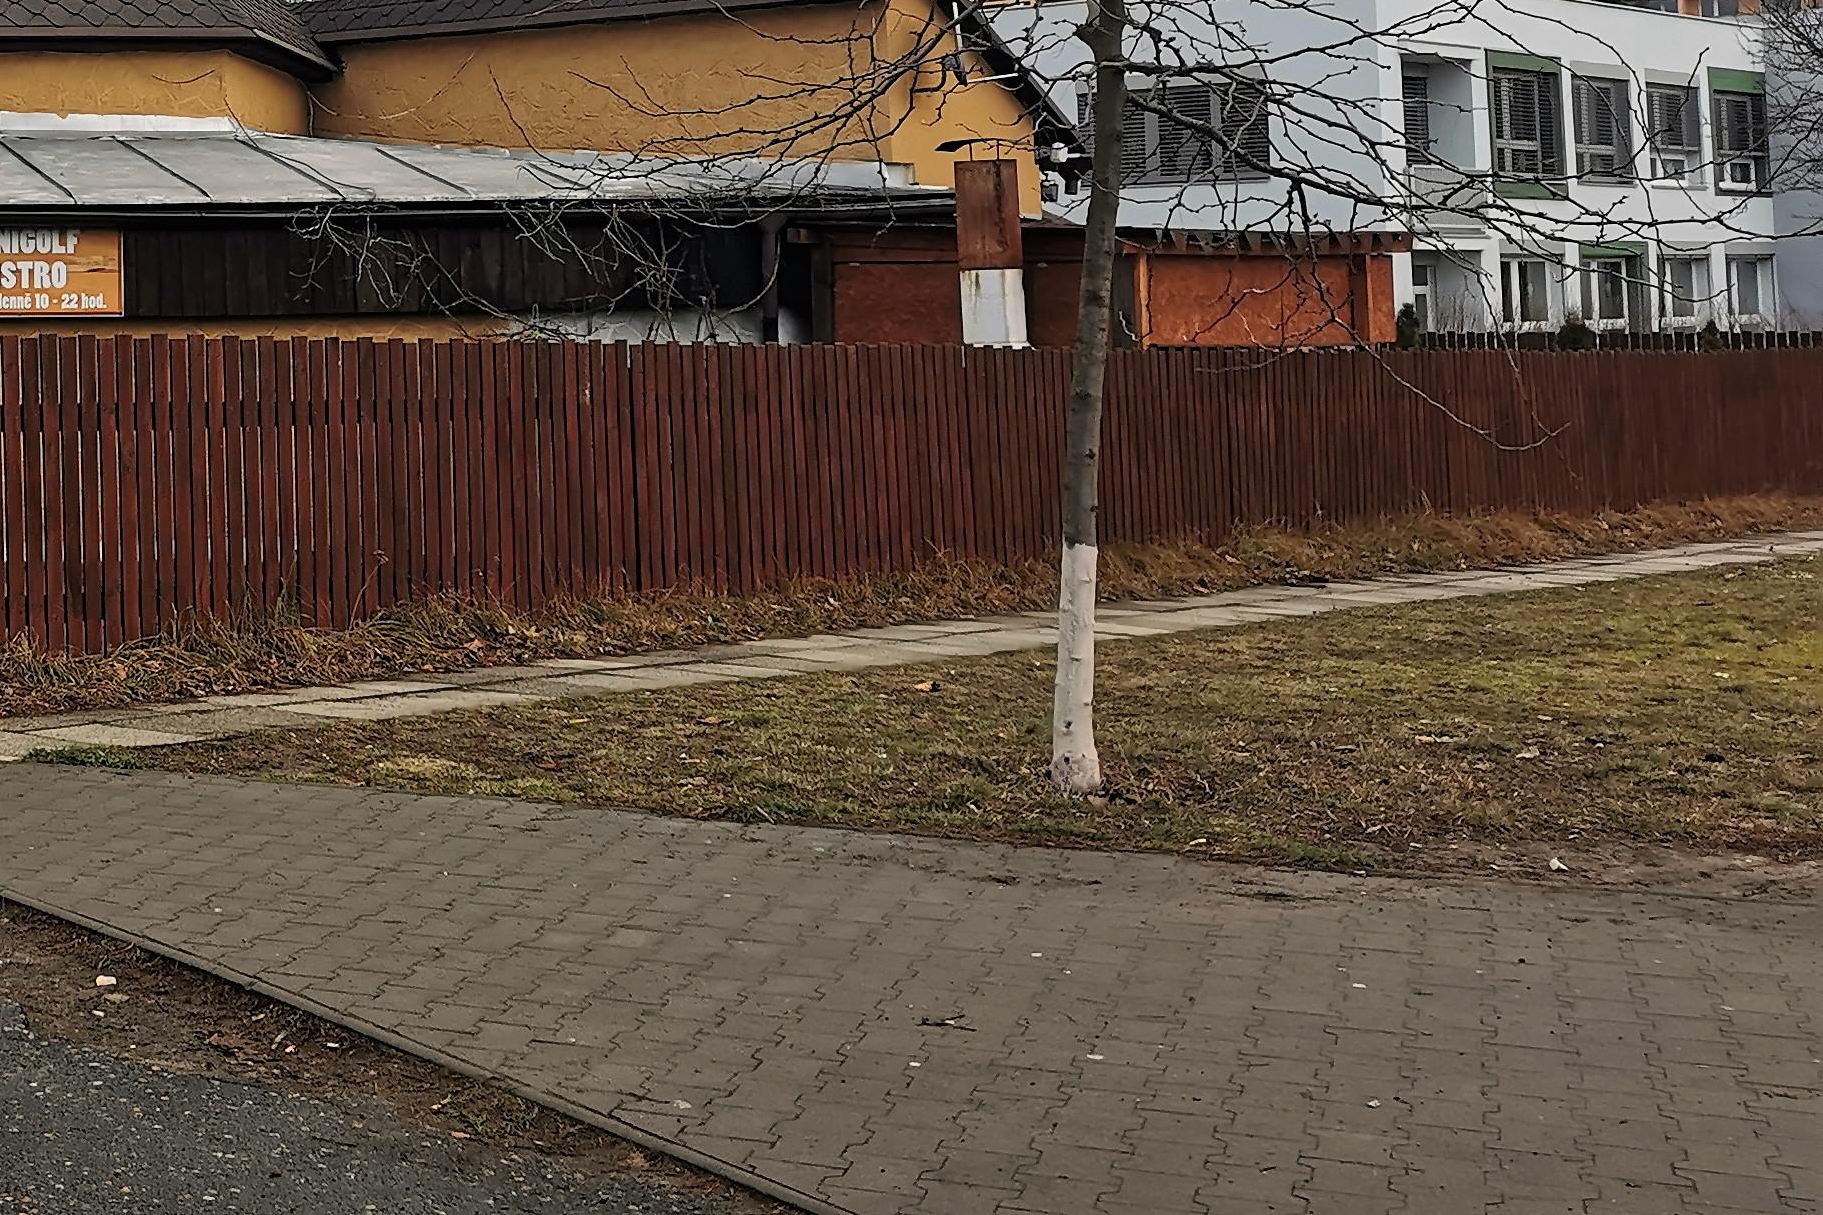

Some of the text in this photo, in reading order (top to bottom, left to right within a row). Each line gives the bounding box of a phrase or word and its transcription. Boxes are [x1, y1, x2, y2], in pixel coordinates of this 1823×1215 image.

[34, 293, 49, 310] 10
[61, 293, 78, 310] 22
[81, 292, 107, 310] hod.
